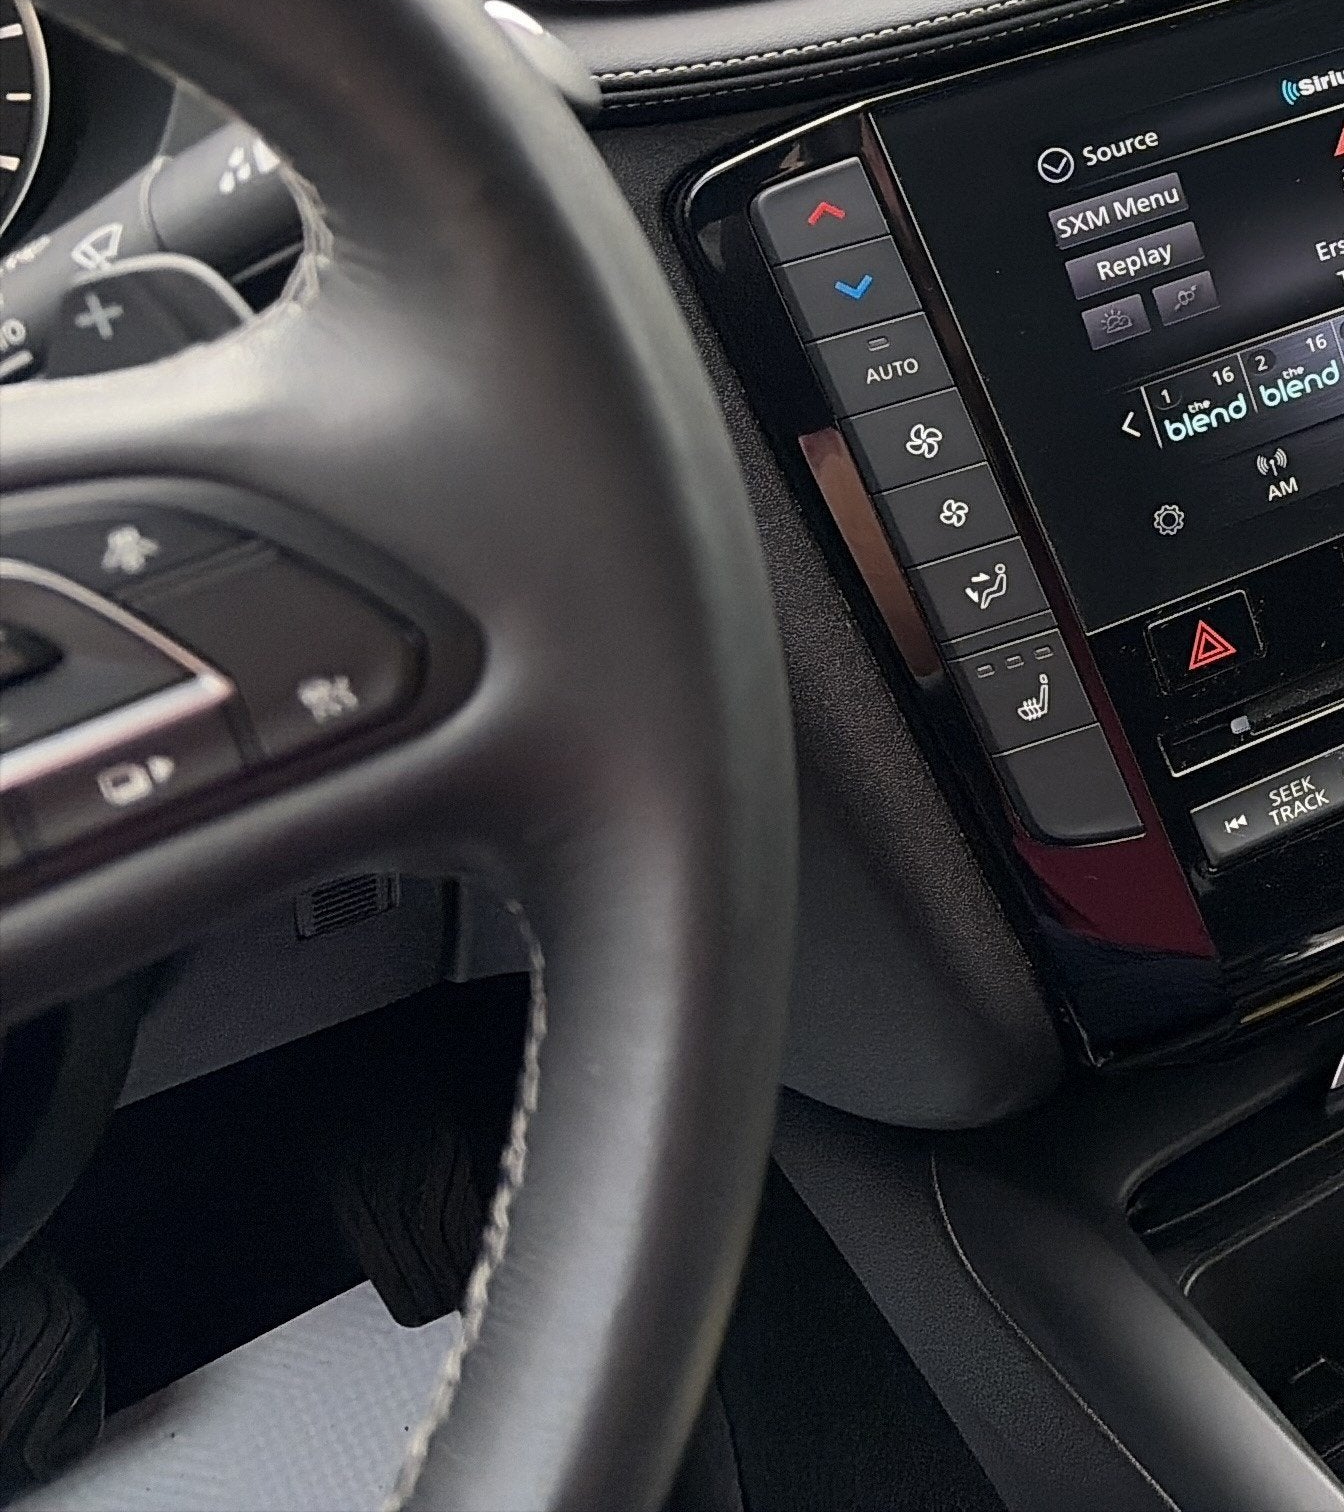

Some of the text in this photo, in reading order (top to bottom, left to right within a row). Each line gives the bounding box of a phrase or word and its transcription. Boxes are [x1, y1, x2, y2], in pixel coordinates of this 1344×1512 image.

[1082, 131, 1159, 166] Source
[1056, 186, 1180, 239] SXM Menu
[1097, 244, 1173, 281] Replay
[1306, 334, 1327, 353] 16
[866, 358, 919, 384] AUTO
[1212, 367, 1235, 386] 16
[1255, 355, 1268, 372] 2
[1282, 365, 1305, 380] the
[1160, 388, 1172, 405] 1
[1259, 360, 1340, 407] blend
[1164, 393, 1248, 442] blend
[1188, 399, 1211, 414] the
[1267, 477, 1299, 501] AM
[1269, 775, 1316, 807] SEEK
[1269, 789, 1330, 826] TRACK
